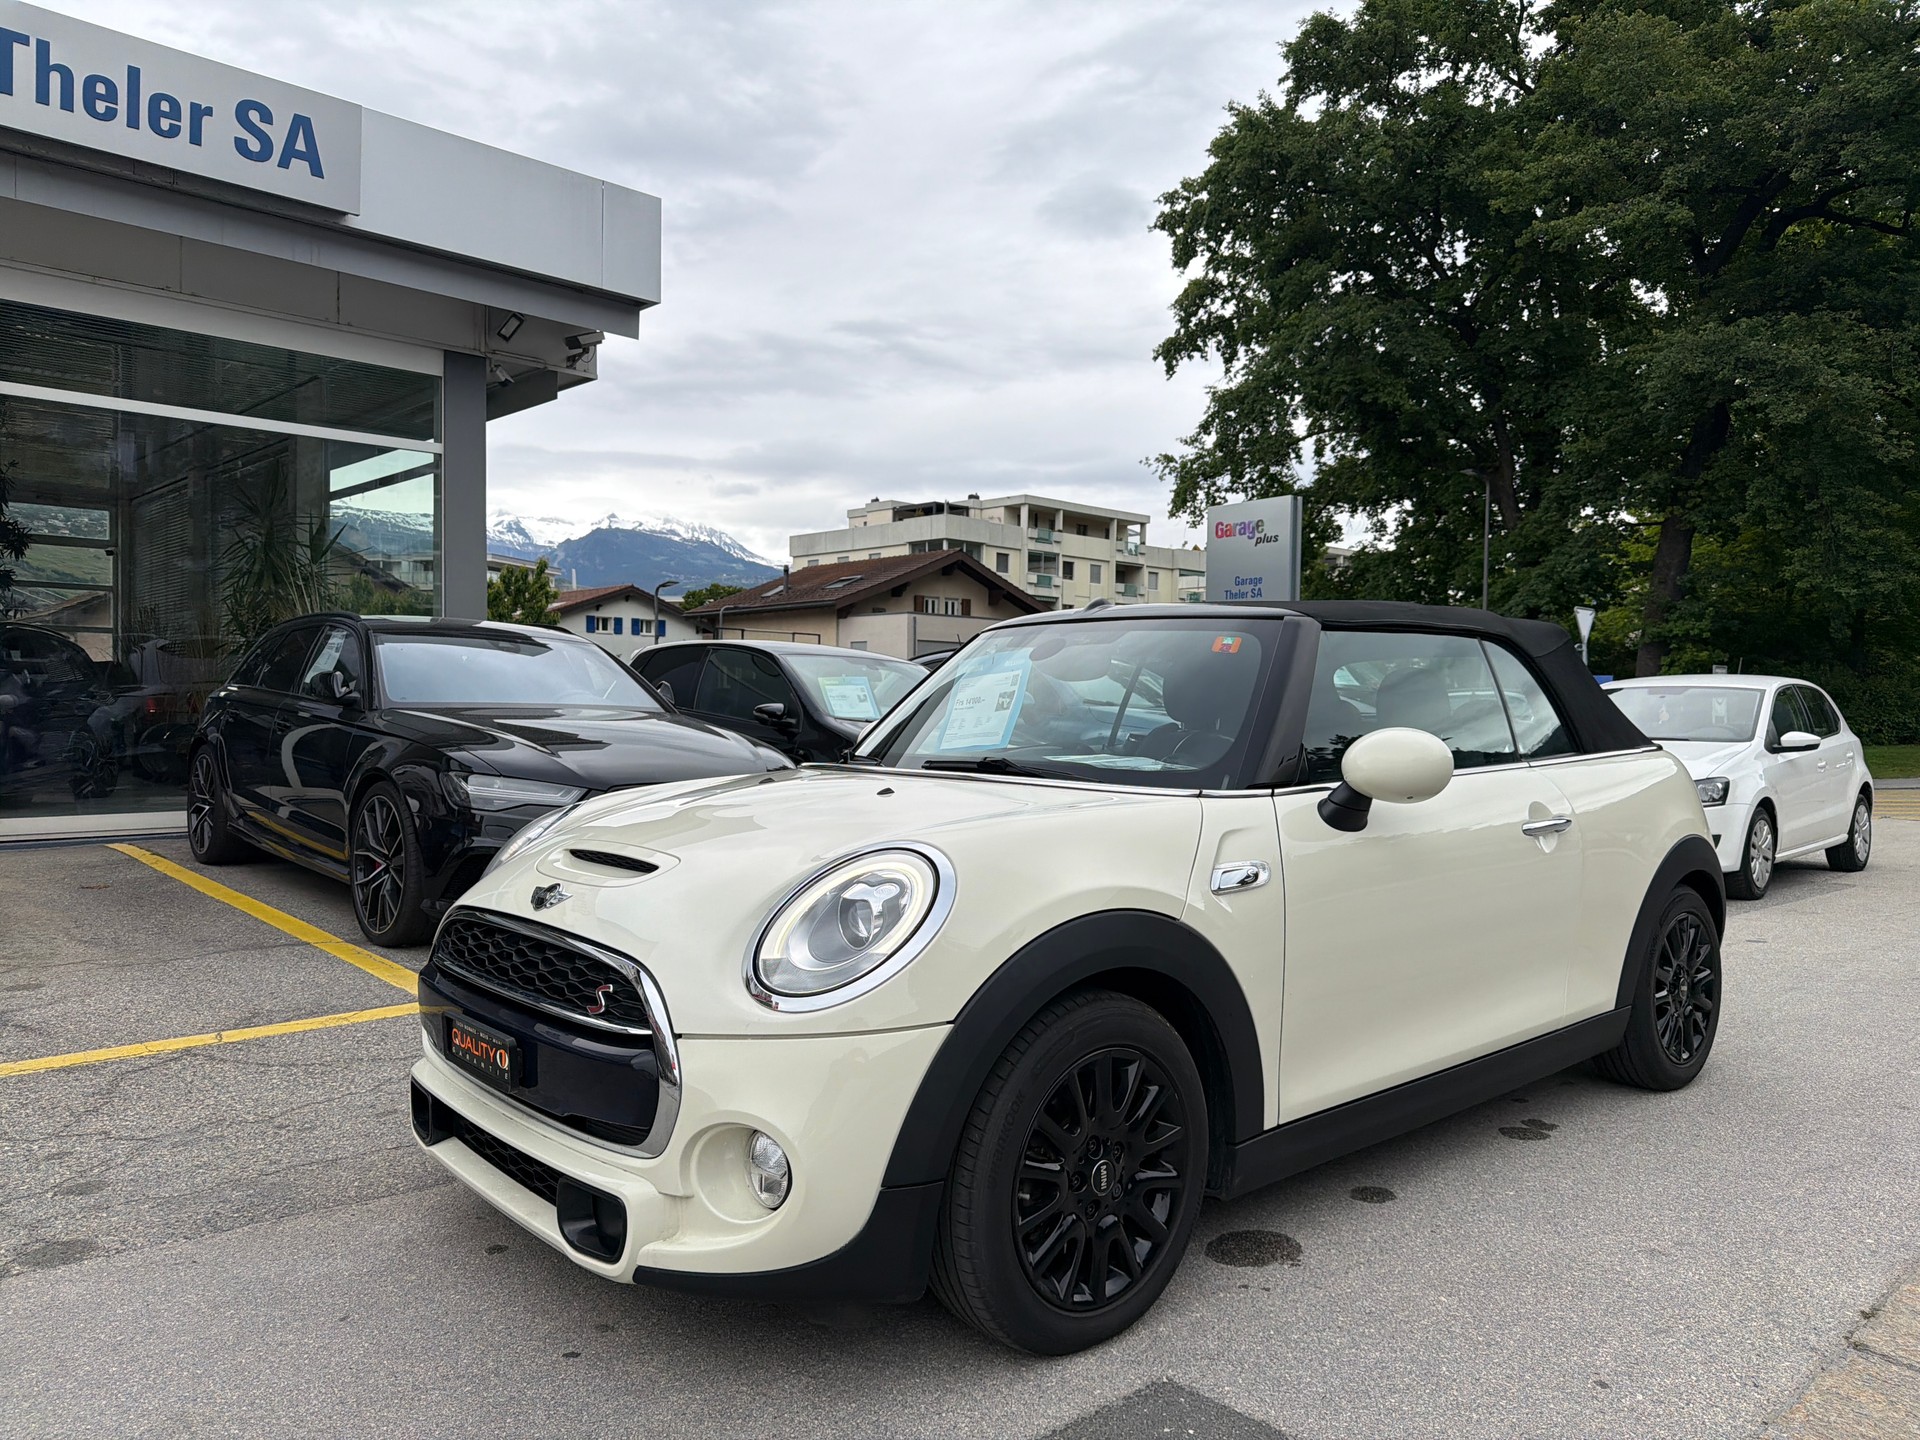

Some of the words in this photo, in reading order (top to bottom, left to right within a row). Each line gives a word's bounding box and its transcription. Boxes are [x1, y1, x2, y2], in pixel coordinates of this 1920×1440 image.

[0, 26, 214, 148] Theler
[233, 98, 325, 180] SA
[1215, 519, 1265, 540] Garage
[1254, 533, 1279, 547] plus
[1224, 589, 1249, 600] Theler
[1250, 587, 1263, 598] SA
[1234, 576, 1263, 588] Garage
[586, 983, 613, 1015] S
[451, 1028, 496, 1063] QUALITY
[1100, 1164, 1108, 1190] MINI
